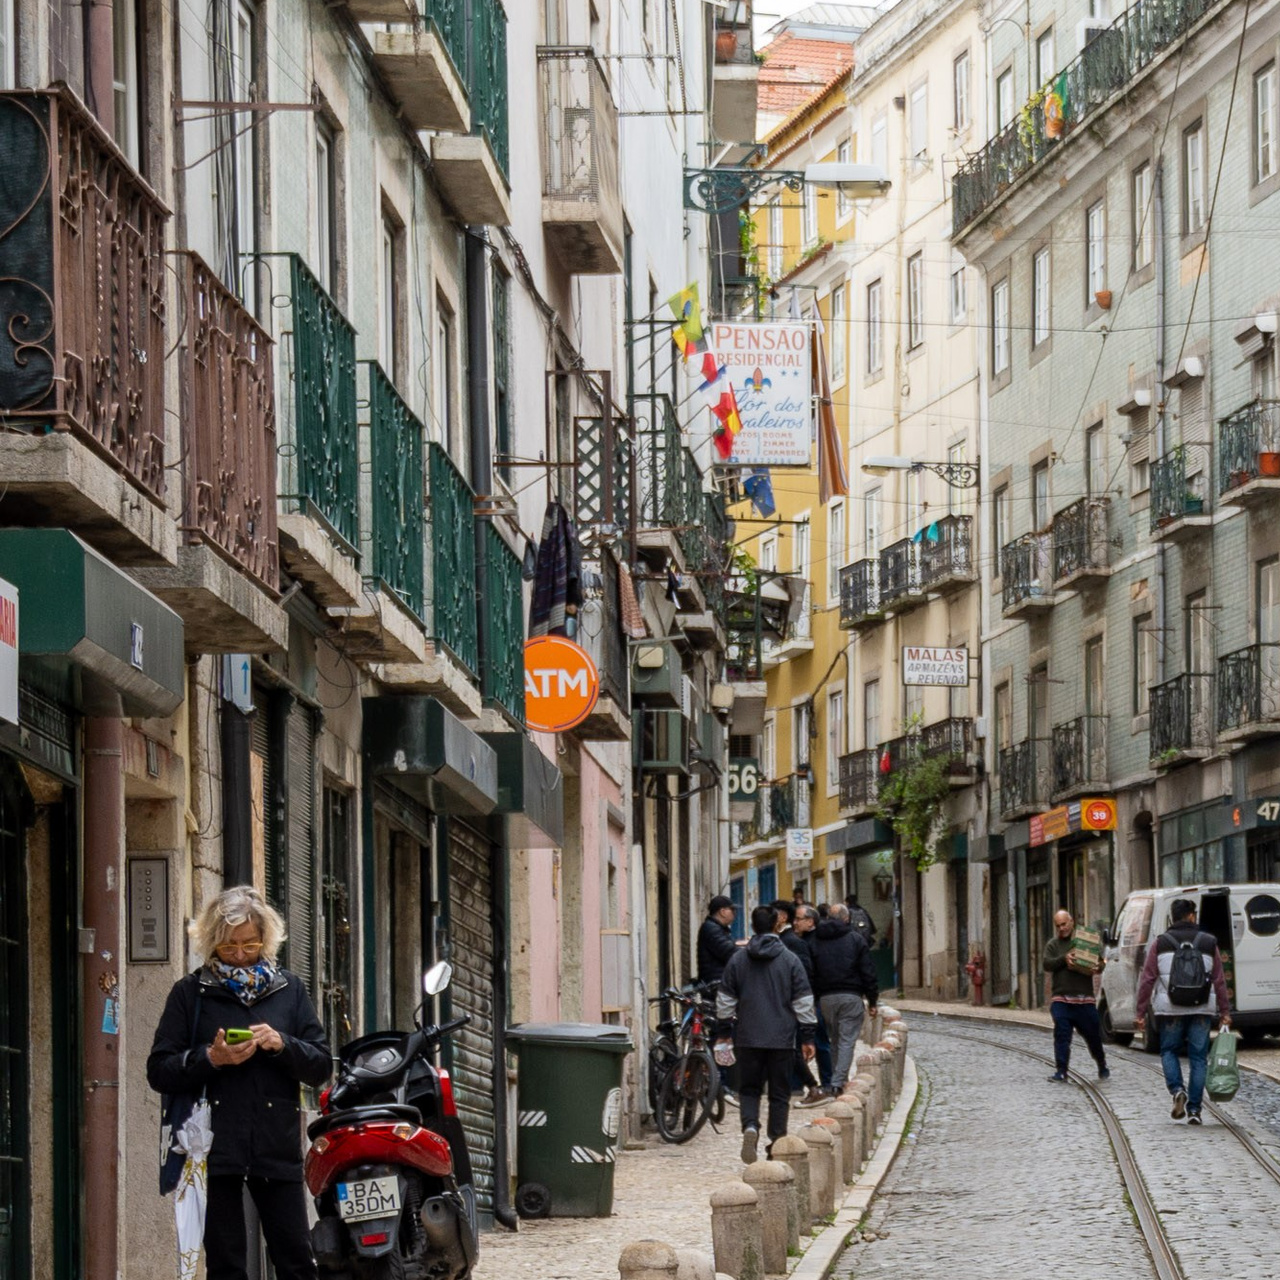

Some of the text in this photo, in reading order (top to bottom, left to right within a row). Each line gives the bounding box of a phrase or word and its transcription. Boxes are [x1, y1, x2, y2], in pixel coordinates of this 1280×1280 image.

[715, 325, 805, 351] PENSÃO
[717, 352, 802, 367] RESIDENCIAL
[774, 396, 803, 412] dos
[907, 648, 965, 663] MALAS
[907, 662, 965, 674] ARMAZÉNS
[524, 668, 588, 698] ATM
[917, 674, 965, 685] REVENDA
[729, 764, 757, 794] 56
[1092, 811, 1107, 821] 39
[1257, 801, 1280, 821] 47
[354, 1181, 382, 1199] BA
[345, 1194, 396, 1216] 35DM
